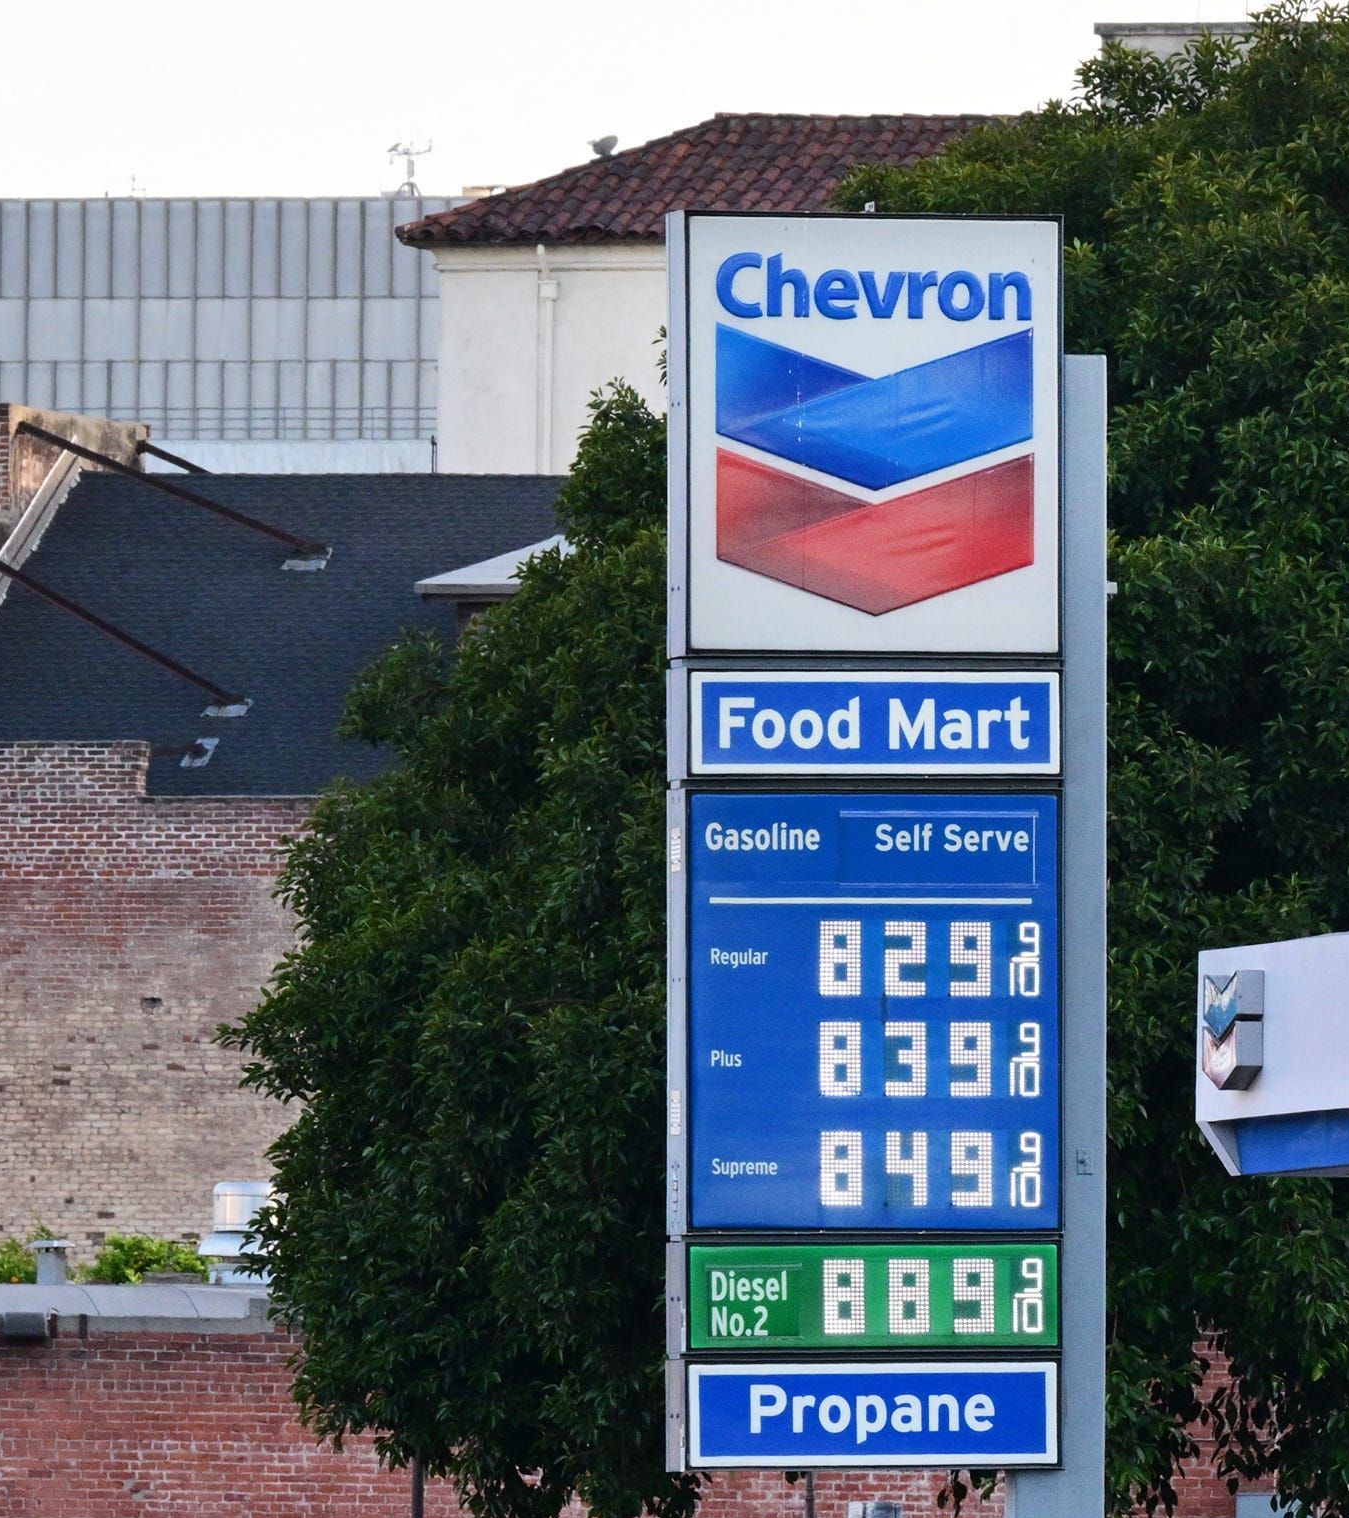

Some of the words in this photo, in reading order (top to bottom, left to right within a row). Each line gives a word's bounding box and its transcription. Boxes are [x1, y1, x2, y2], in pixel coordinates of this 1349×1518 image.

[716, 252, 1033, 321] Chevron
[719, 696, 861, 750] Food
[888, 696, 1030, 750] Mart
[705, 822, 821, 851] Gasoline
[875, 823, 933, 852] Self
[943, 823, 1030, 852] Serve
[710, 948, 768, 969] Regular
[819, 920, 992, 996] 829
[710, 1050, 743, 1067] Plus
[819, 1021, 992, 1097] 839
[711, 1158, 779, 1179] Supreme
[820, 1131, 993, 1207] 849
[710, 1270, 788, 1301] Diesel
[822, 1258, 995, 1334] 889
[711, 1306, 769, 1336] No.2
[750, 1384, 995, 1444] Propane
